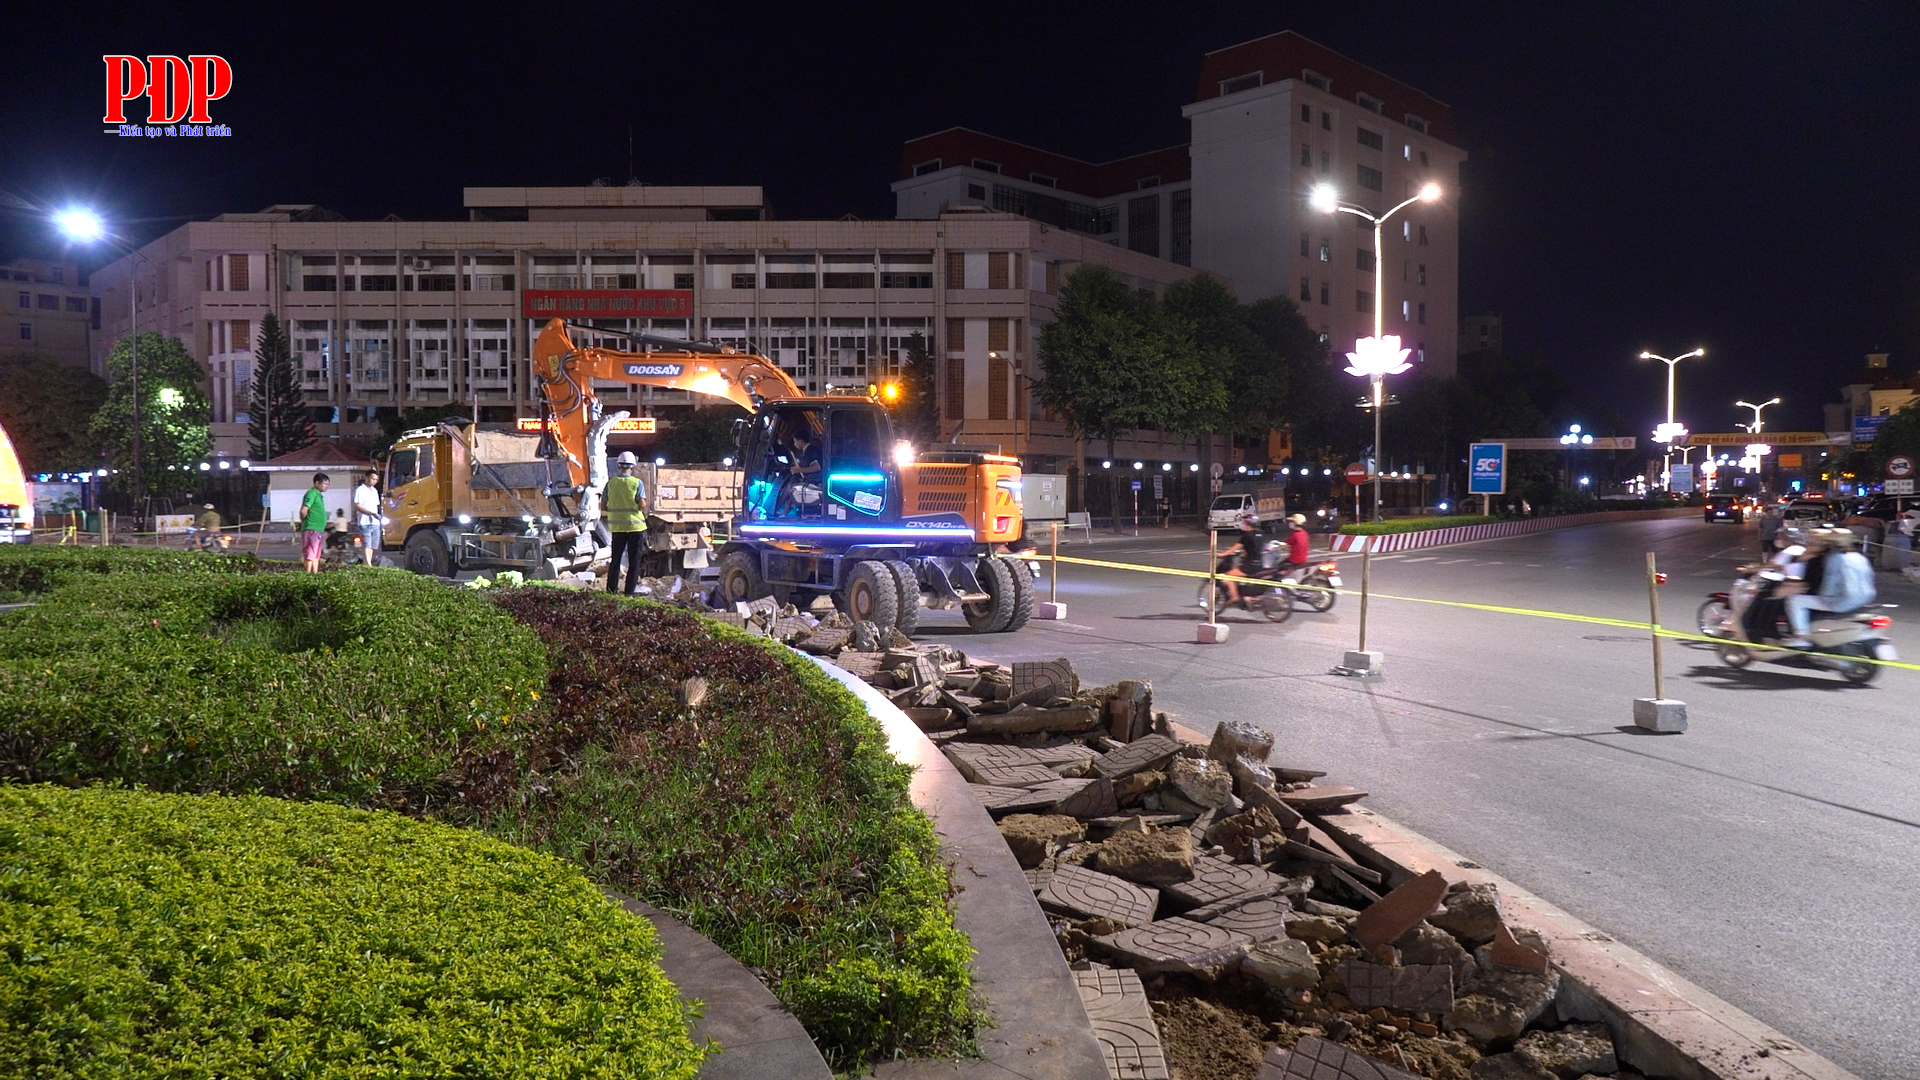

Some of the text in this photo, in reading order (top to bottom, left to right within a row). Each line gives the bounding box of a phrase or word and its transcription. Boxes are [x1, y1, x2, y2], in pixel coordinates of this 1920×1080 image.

[531, 294, 686, 313] NGÂN HÀNG NHÀ NƯỚC KHU VỰC 5
[628, 363, 680, 375] DOOSAN
